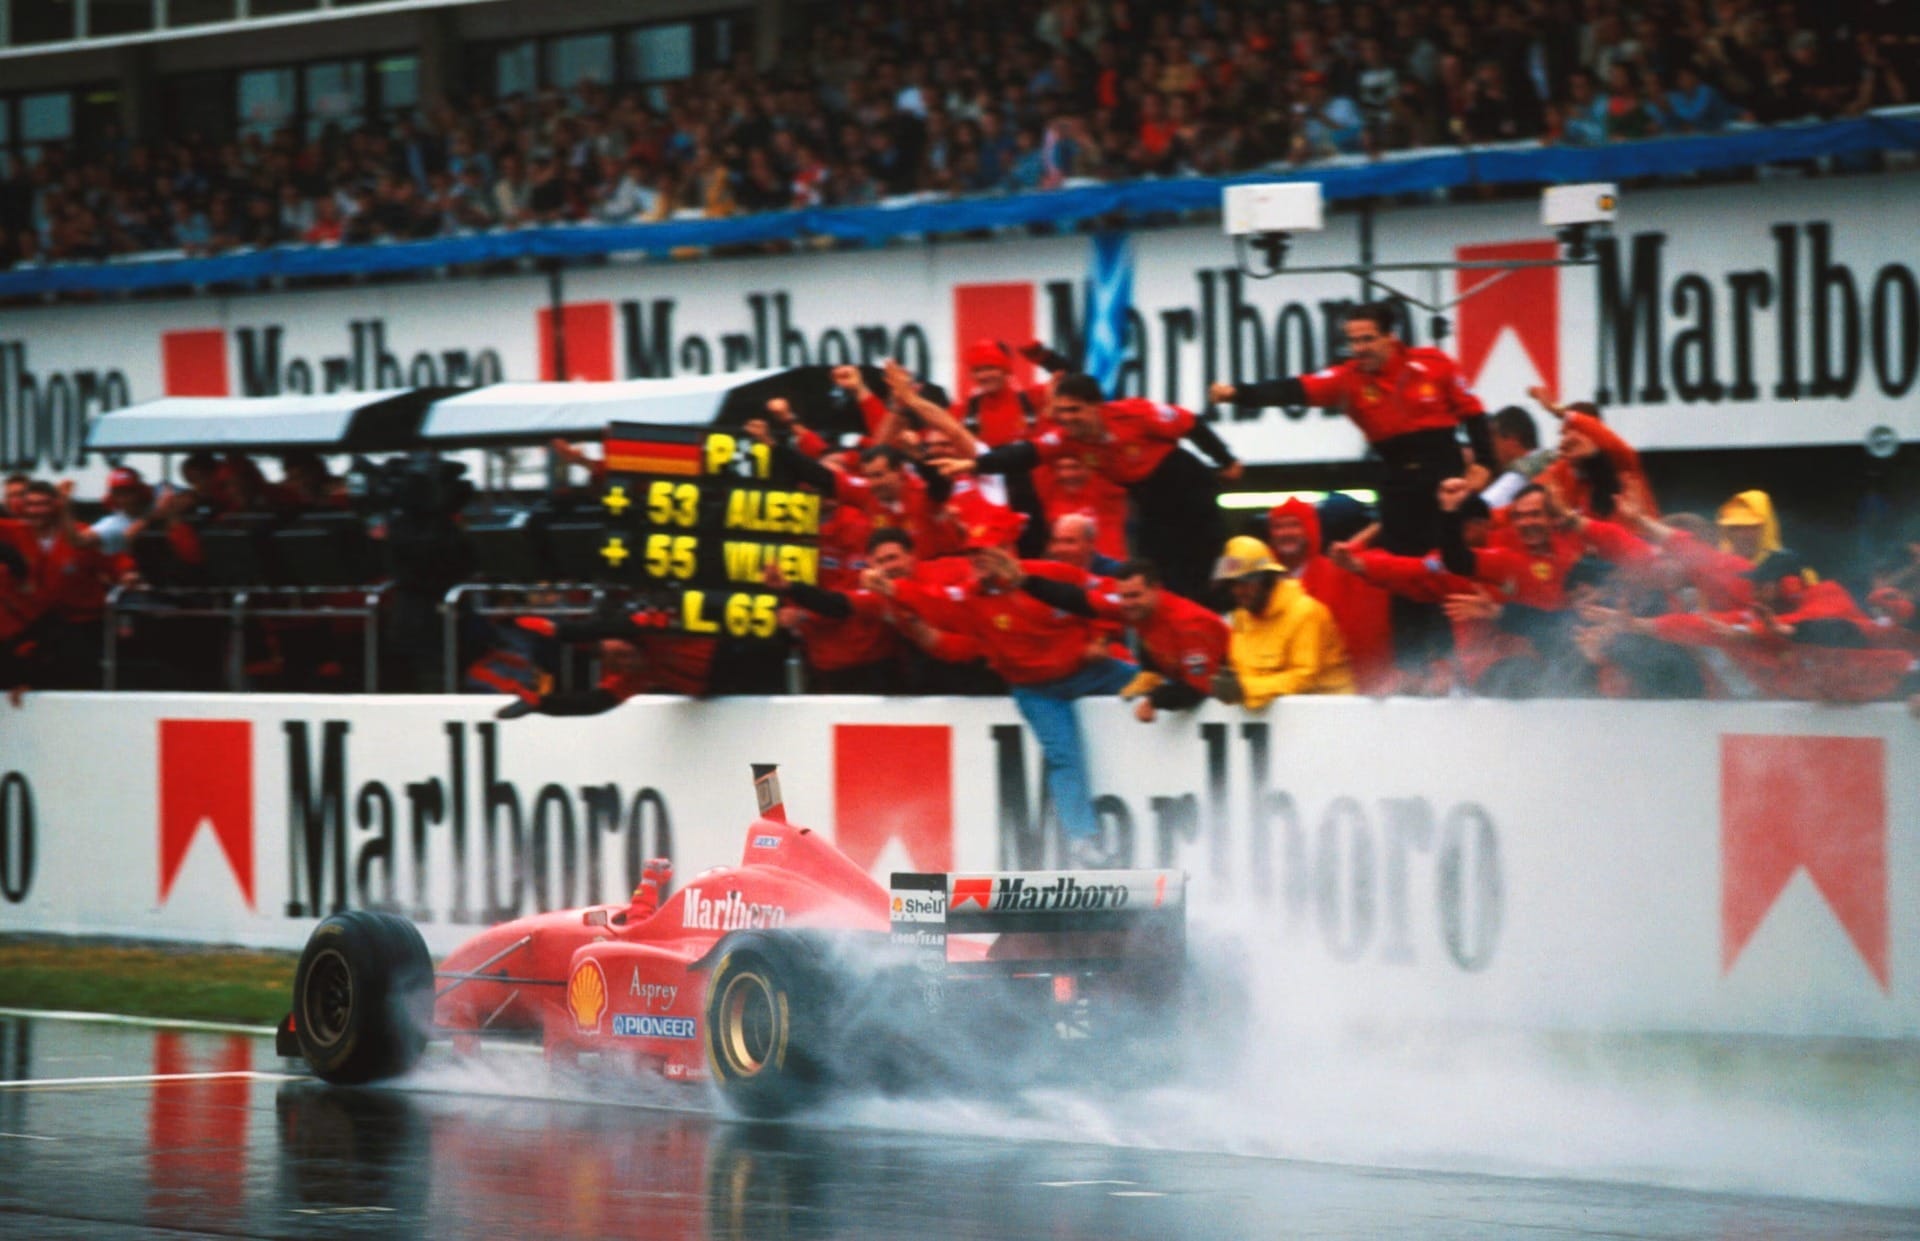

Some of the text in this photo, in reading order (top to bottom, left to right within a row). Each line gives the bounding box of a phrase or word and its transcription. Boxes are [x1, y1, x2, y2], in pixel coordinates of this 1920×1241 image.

[1595, 220, 1920, 405] Marlbo
[648, 481, 699, 527] 53
[646, 534, 697, 580] 55
[682, 590, 778, 637] L 65
[282, 719, 672, 924] Marlboro
[682, 887, 785, 931] Marlboro
[905, 898, 943, 914] Shell
[993, 876, 1129, 912] Marlboro
[629, 964, 678, 1012] Asprey
[625, 1015, 695, 1037] PIONEER
